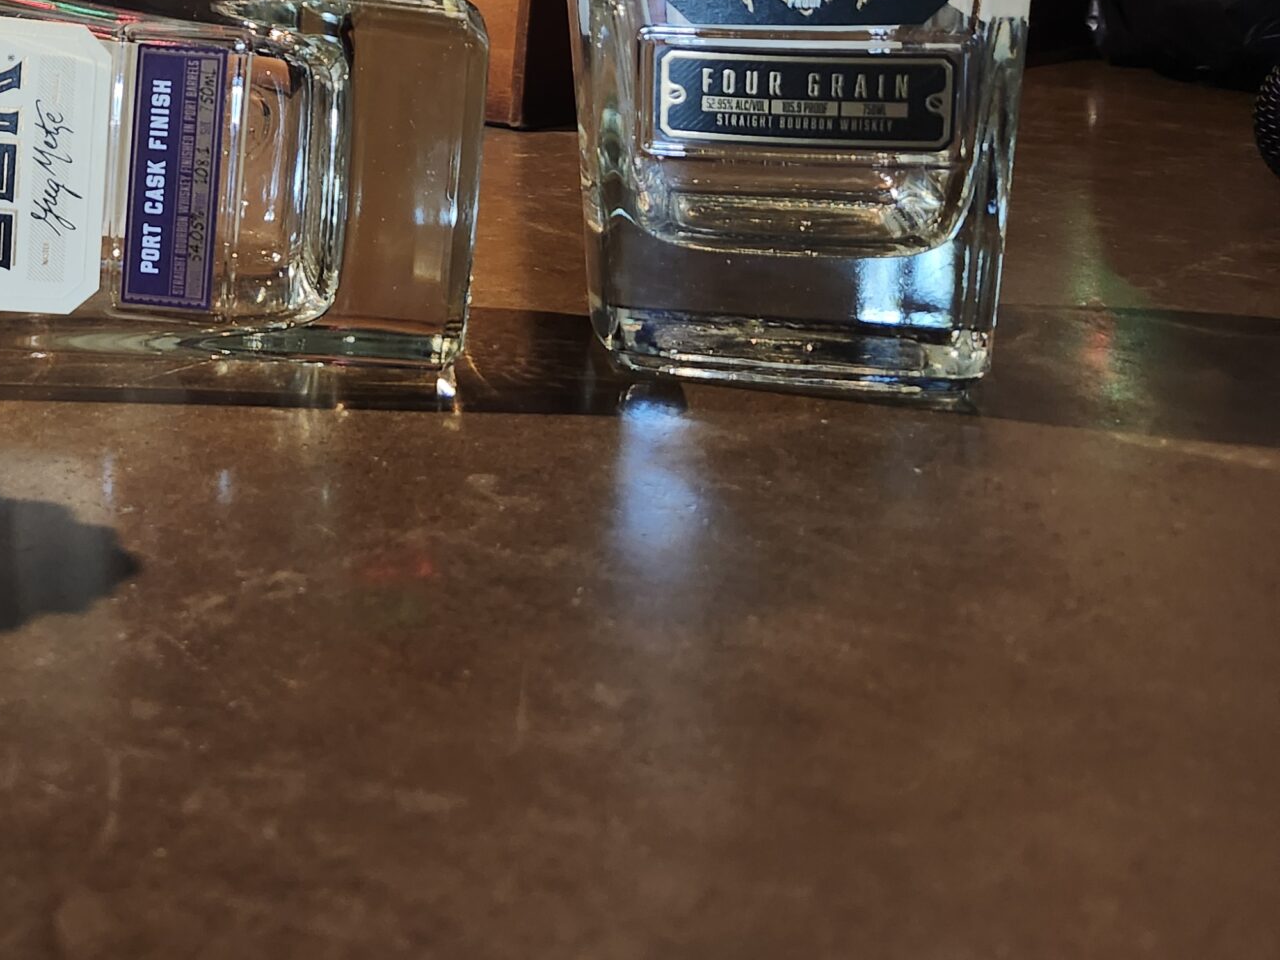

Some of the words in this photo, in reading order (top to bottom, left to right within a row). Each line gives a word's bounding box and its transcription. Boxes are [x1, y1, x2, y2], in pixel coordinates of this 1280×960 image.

[185, 59, 200, 97] BARRELS
[702, 67, 783, 96] FOUR
[807, 72, 910, 100] GRAIN
[148, 79, 172, 150] FINISH
[183, 99, 197, 121] PORT
[716, 113, 773, 129] STRAIGHT
[779, 116, 834, 131] BOURBON
[839, 119, 894, 133] WHISKEY
[180, 135, 195, 174] FINISHED
[144, 159, 167, 215] CASK
[177, 172, 192, 214] WHISKEY
[140, 222, 162, 274] PORT
